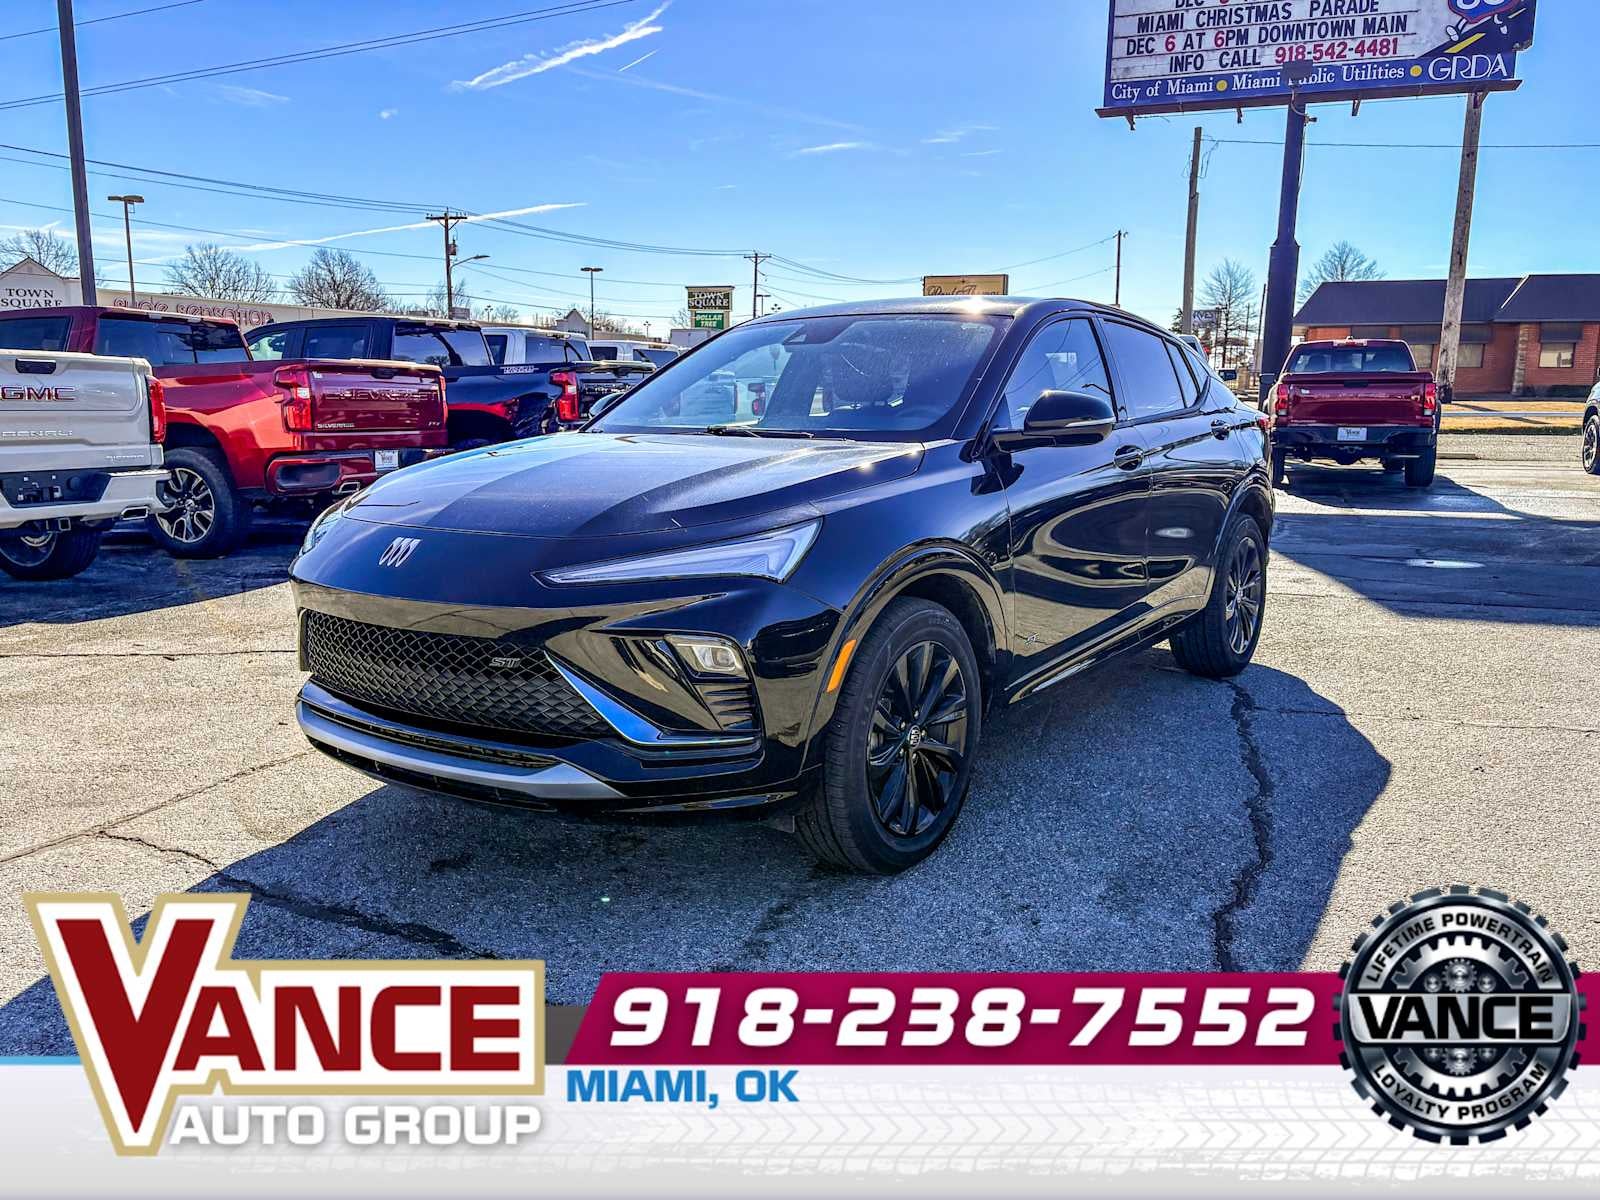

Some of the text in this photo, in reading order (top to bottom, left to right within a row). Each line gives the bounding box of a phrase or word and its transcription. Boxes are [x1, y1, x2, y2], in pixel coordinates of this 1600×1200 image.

[1137, 0, 1379, 33] MIAMI CHRISTMAS PARADE
[1126, 15, 1408, 55] DEC 6 AT 6PM DOWNTOWN MAIN
[1169, 37, 1399, 73] INFO CALL 918-542-4481
[1111, 53, 1508, 103] City of Miami Miami blic Utilities GRDA
[1, 298, 63, 308] SQUARE
[6, 288, 54, 298] TOWN
[688, 299, 729, 308] SQUARE
[0, 386, 75, 401] GMC
